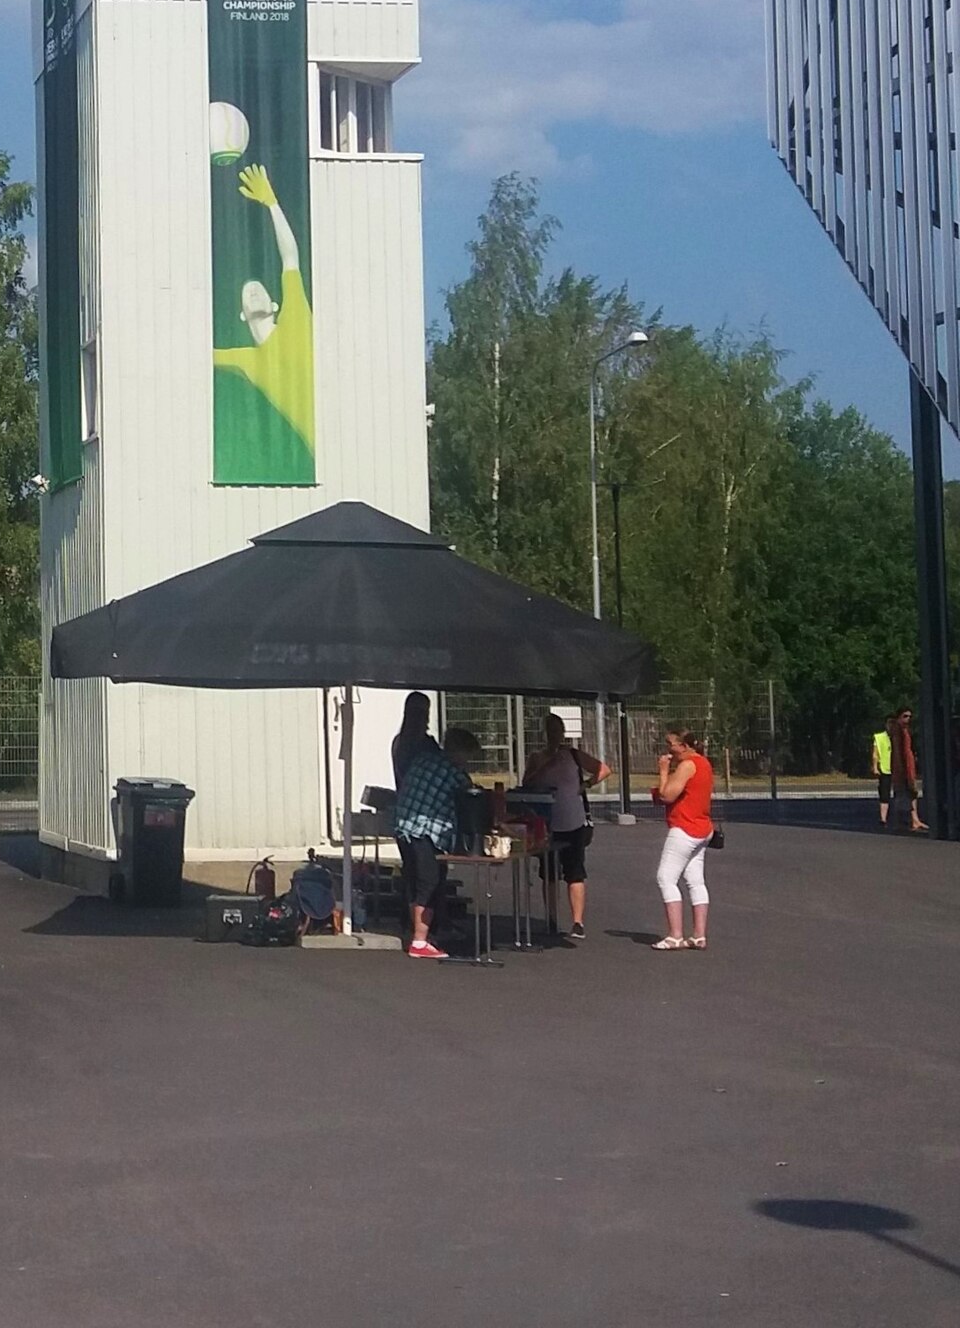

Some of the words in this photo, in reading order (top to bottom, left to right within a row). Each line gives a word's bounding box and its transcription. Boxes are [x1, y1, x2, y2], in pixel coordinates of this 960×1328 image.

[223, 1, 296, 10] CHAMPIONSHIP
[230, 12, 268, 21] FINLAND
[269, 12, 289, 21] 2018
